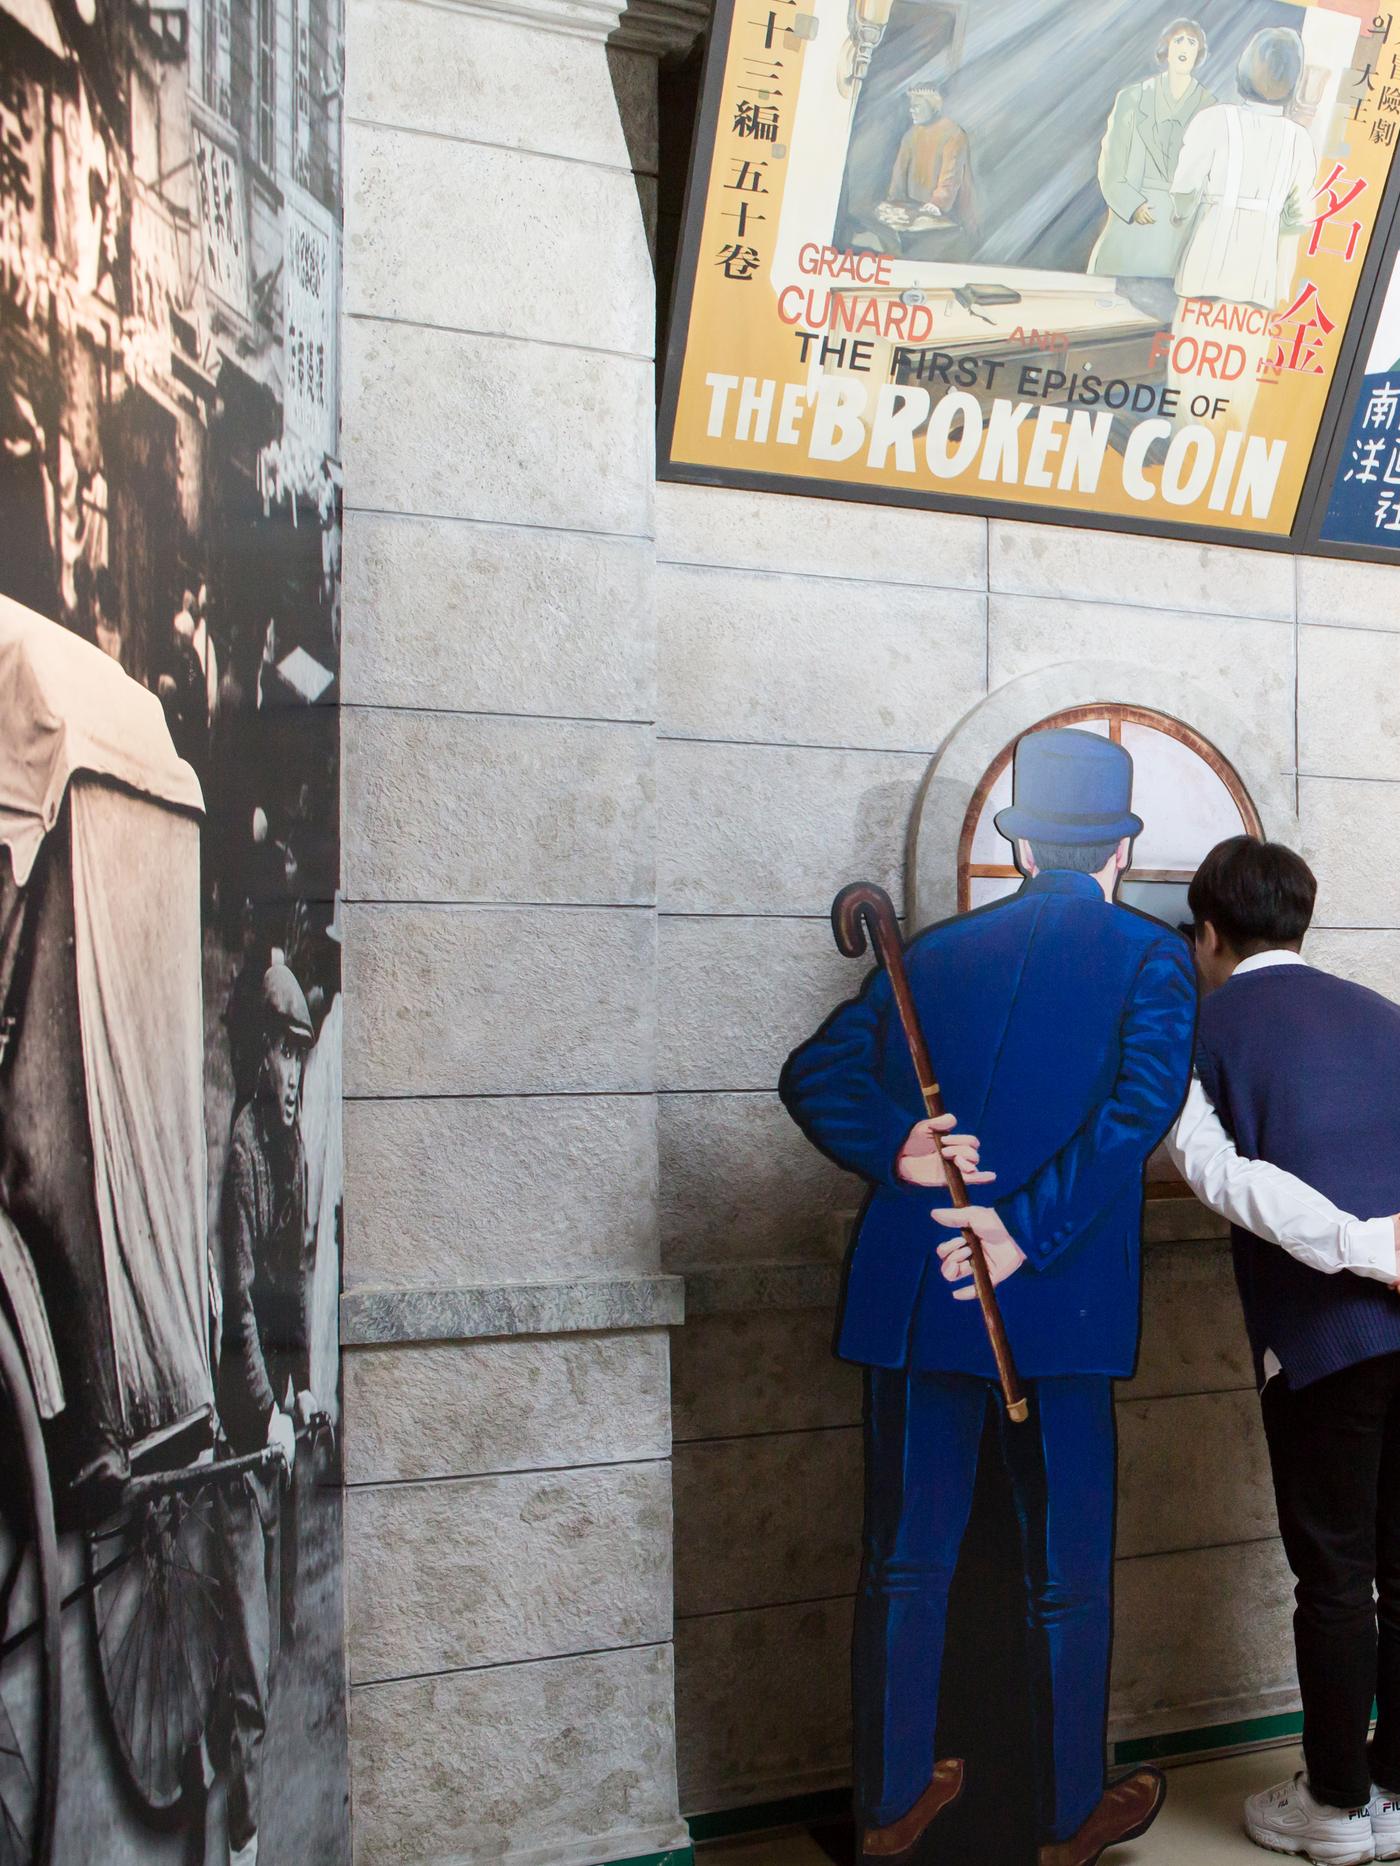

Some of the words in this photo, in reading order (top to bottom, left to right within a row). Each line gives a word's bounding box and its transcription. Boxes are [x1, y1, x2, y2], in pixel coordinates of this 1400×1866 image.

[732, 0, 797, 143] 十三編
[798, 242, 896, 286] GRACE
[777, 285, 934, 342] CUNARD
[1007, 326, 1070, 352] AND
[1180, 297, 1284, 338] FRANCIS
[795, 331, 874, 373] THE
[890, 344, 1005, 391] FIRST
[1017, 365, 1181, 418] EPISODE
[1190, 394, 1230, 420] OF
[1147, 332, 1247, 381] FORD
[705, 372, 808, 445] THE
[808, 373, 1113, 494] BROKEN
[1122, 418, 1288, 520] COIN
